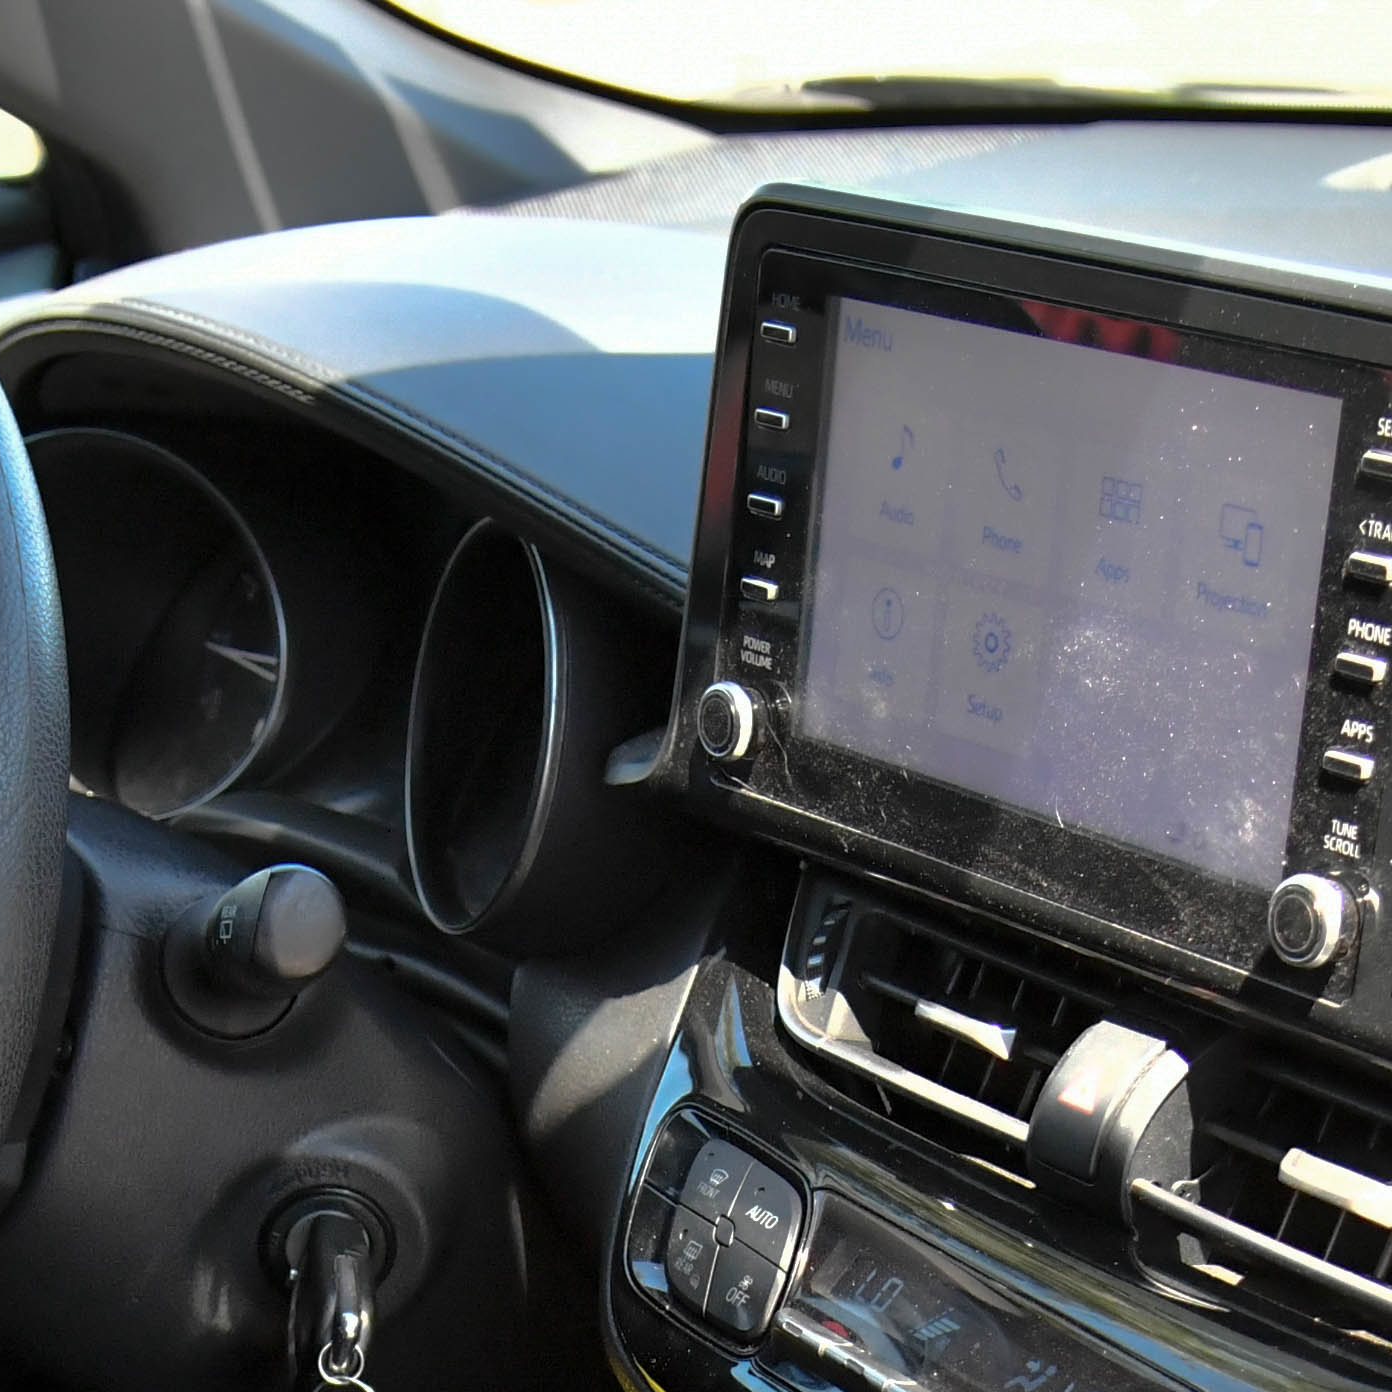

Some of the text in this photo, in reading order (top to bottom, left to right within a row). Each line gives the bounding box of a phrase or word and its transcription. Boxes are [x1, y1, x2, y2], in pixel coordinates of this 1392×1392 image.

[771, 293, 801, 312] HOME
[843, 315, 894, 352] Menu
[764, 377, 794, 399] MENU
[757, 463, 787, 486] AUDIO
[982, 525, 1023, 554] Phone
[752, 550, 776, 569] MAP
[1348, 617, 1392, 646] PHONE
[742, 634, 772, 655] POWER
[739, 649, 773, 671] VOLUME
[967, 693, 1004, 723] Setup
[1340, 718, 1375, 743] APPS
[1330, 818, 1358, 840] TUNE
[1322, 834, 1360, 859] SCROLL
[696, 1180, 721, 1200] FRONT
[744, 1204, 780, 1230] AUTO
[725, 1286, 751, 1306] OFF
